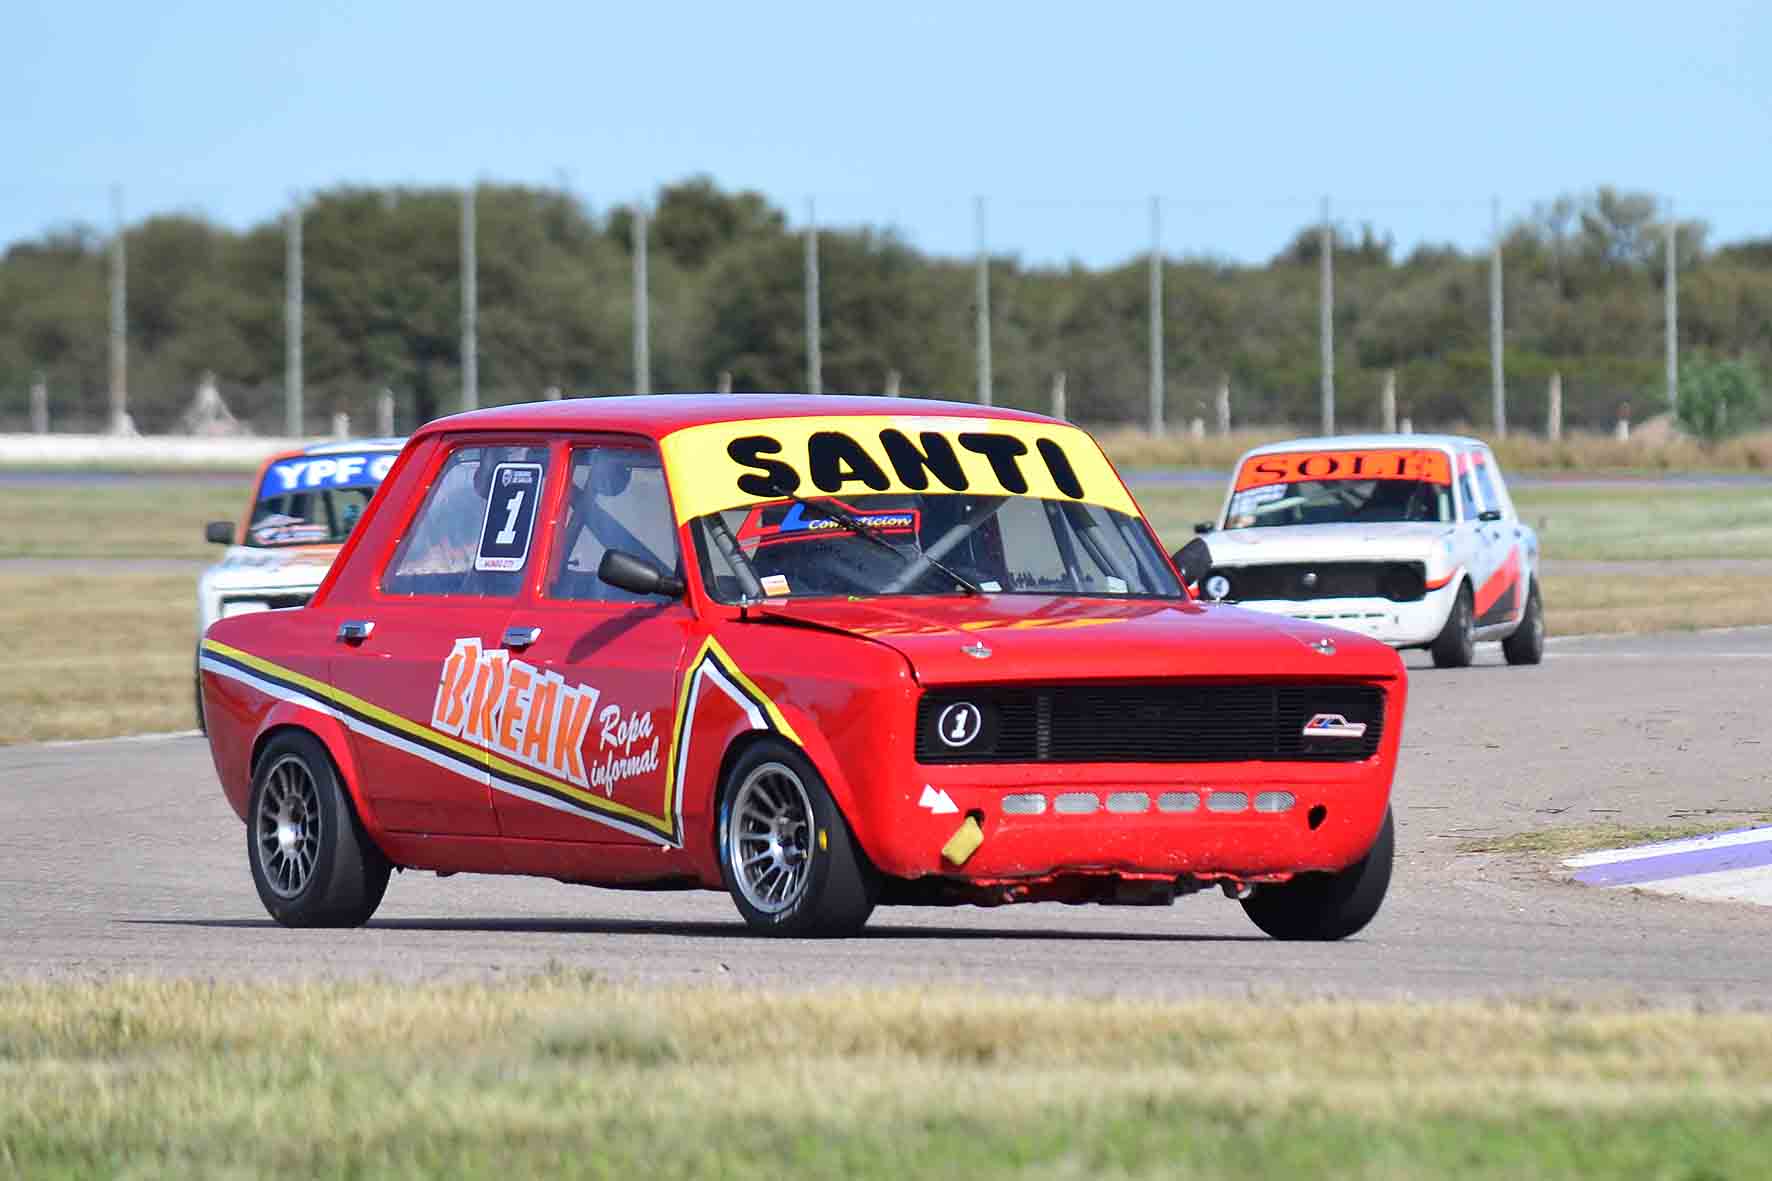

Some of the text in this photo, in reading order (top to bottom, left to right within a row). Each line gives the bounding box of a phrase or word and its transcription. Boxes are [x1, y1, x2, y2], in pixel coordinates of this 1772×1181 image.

[275, 456, 367, 491] YPF
[727, 428, 1084, 499] SANTI
[495, 490, 525, 544] 1
[432, 637, 591, 788] BREAK
[599, 703, 654, 752] Ropa
[951, 709, 969, 739] 1
[591, 736, 660, 798] informal
